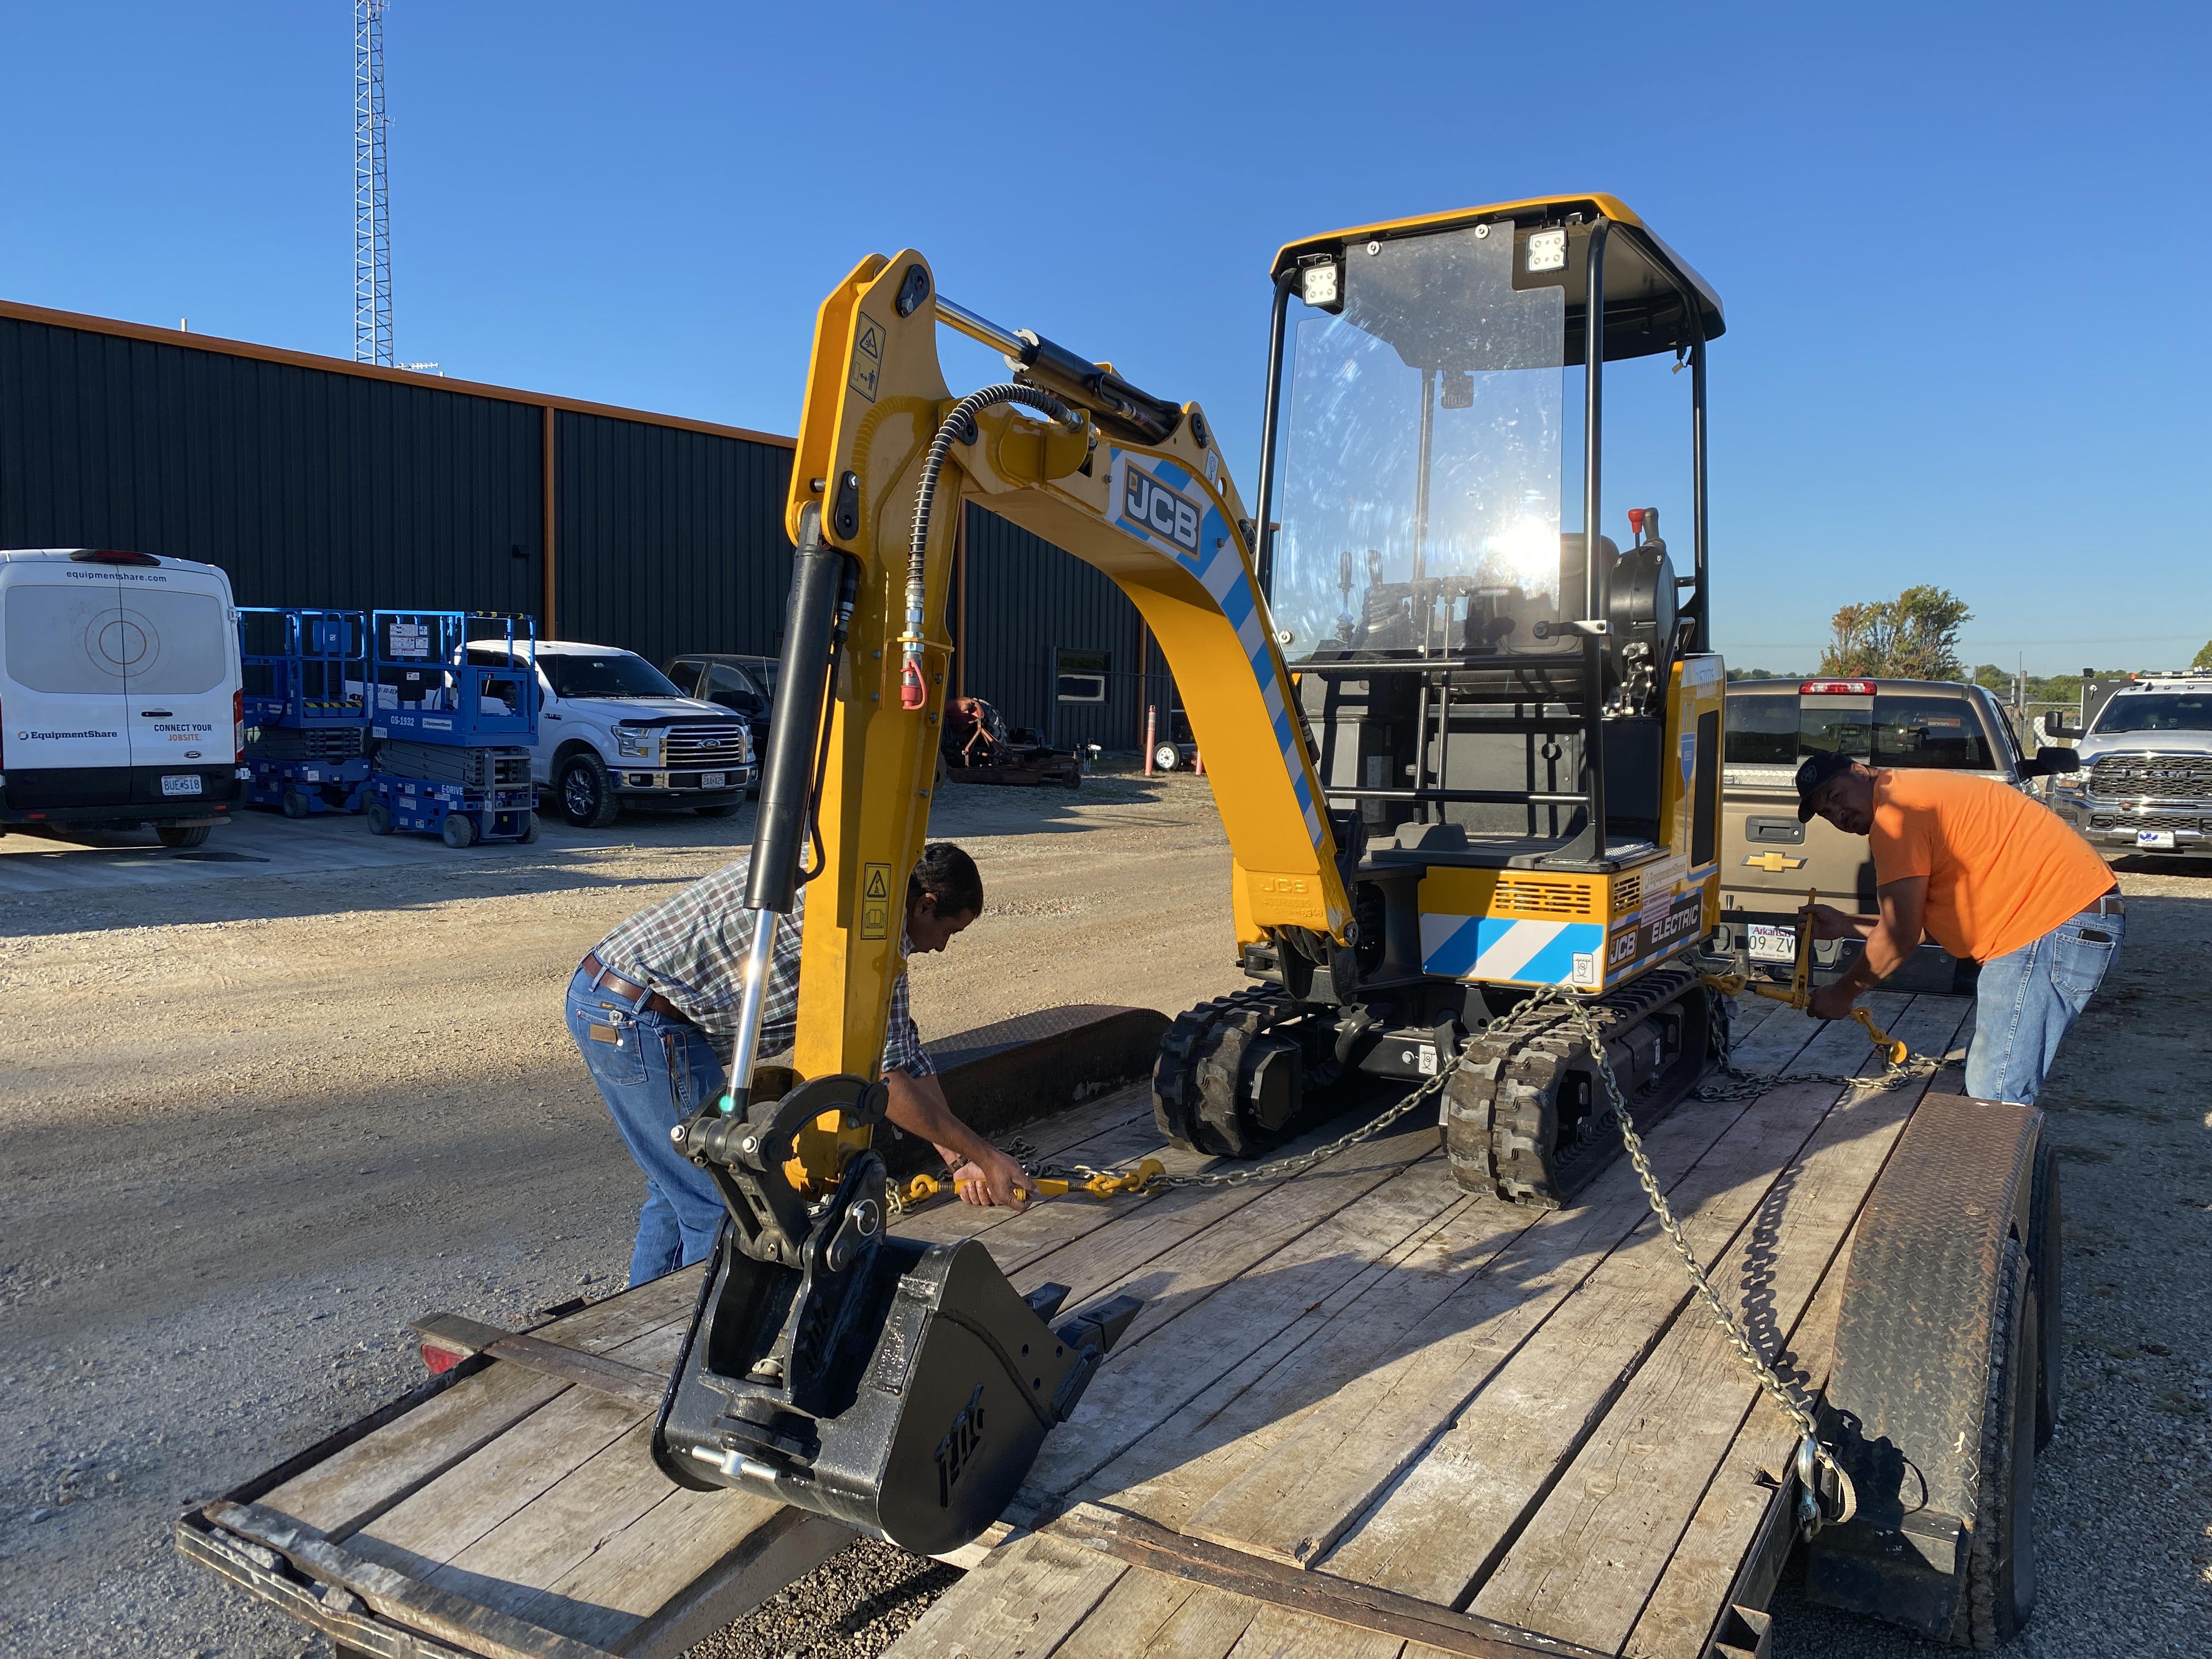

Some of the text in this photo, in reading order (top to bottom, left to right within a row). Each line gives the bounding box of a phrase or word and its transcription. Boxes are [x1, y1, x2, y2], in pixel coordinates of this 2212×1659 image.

[1127, 479, 1198, 548] JCB
[66, 571, 167, 582] equipmentshare.com
[391, 715, 414, 726] GS-1932
[31, 731, 117, 740] EquipmentShare
[442, 785, 463, 795] E-DRIVE
[1650, 862, 1686, 886] EquipmentShare
[1261, 877, 1308, 894] JCB
[1651, 904, 1699, 944] ELECTRIC
[1752, 926, 1791, 937] Arkansas
[1610, 931, 1636, 964] JCB
